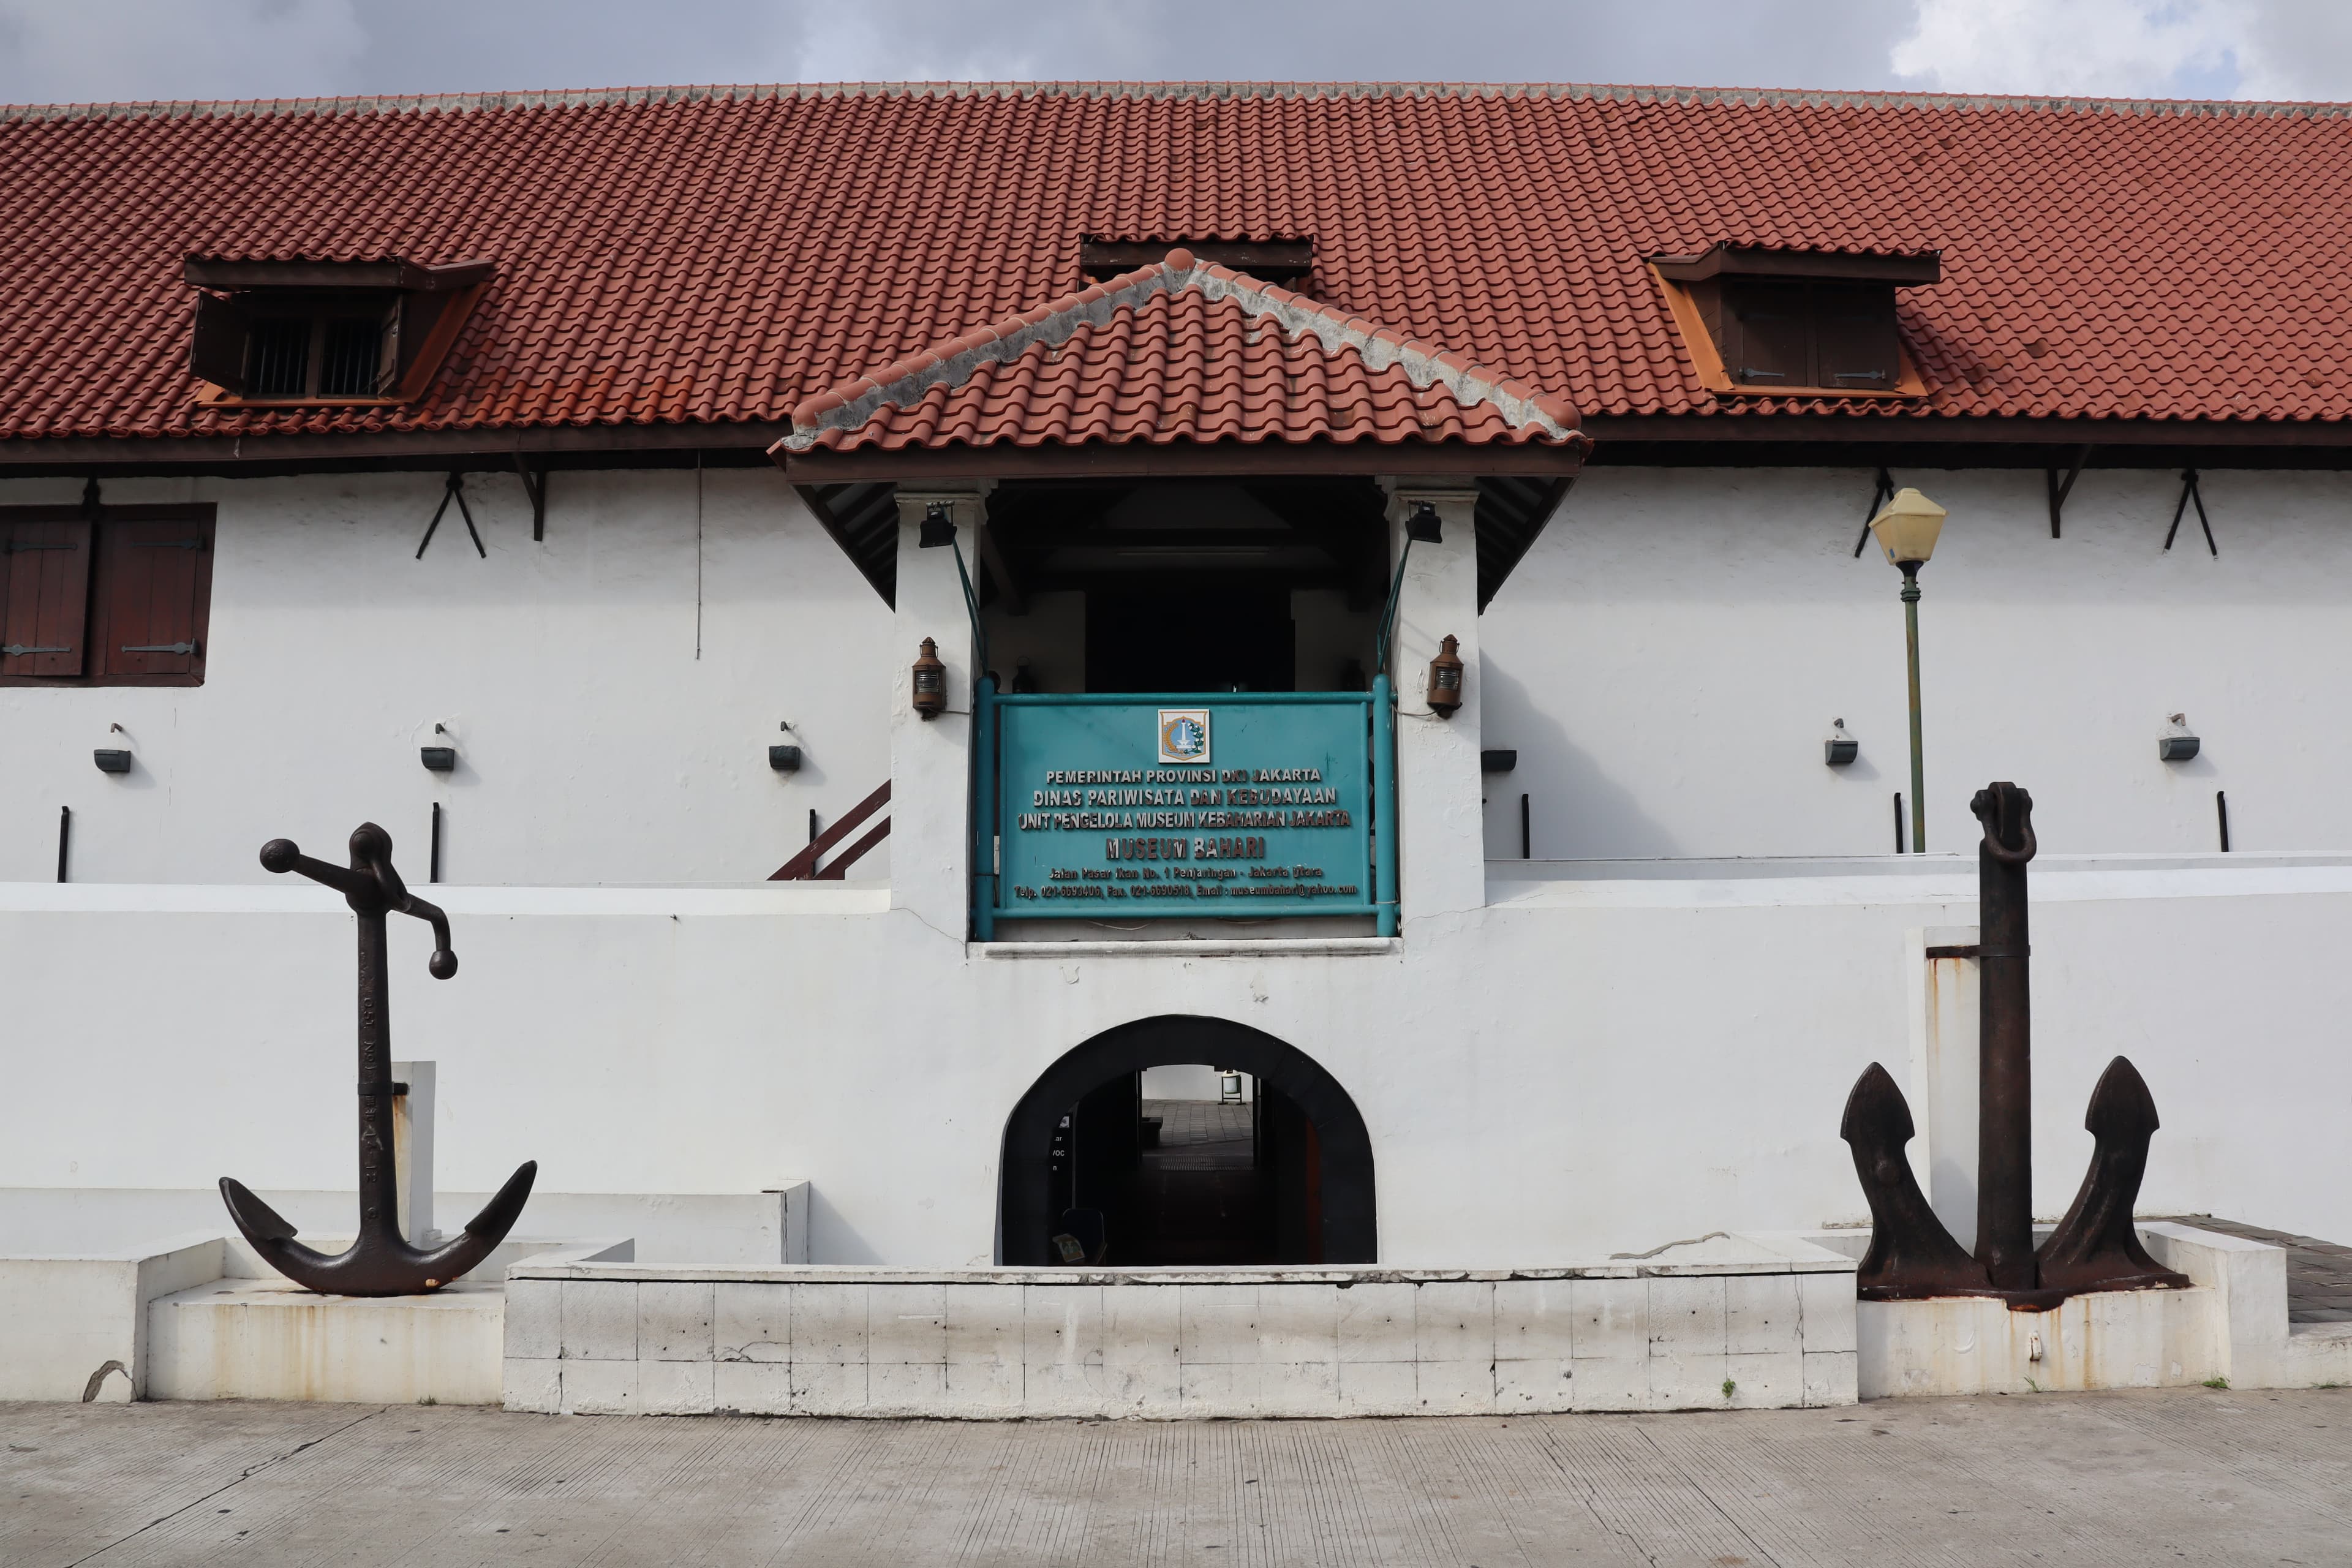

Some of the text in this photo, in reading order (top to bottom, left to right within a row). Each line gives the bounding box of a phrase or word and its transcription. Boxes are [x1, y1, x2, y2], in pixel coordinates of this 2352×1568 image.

[1046, 769, 1321, 784] PEMERINTAH PROVINSI DKI JAKARTA
[1033, 788, 1336, 807] DINAS PARIWISATA DAN KEBUDAYAAN
[1018, 810, 1351, 829] UNIT PENGELOLA MUSEUM KEBAHARIAN JAKARTA
[1106, 837, 1264, 859] MUSEUM BAHARI
[1049, 867, 1077, 879] Jalan
[1082, 867, 1112, 879] Pasar
[1115, 867, 1137, 878] Ikan
[1143, 867, 1159, 878] No.
[1164, 867, 1169, 878] 1
[1174, 867, 1236, 881] Penjaringan
[1248, 865, 1289, 877] Jakarta
[1292, 865, 1323, 878] Utara
[1014, 886, 1037, 899] Telp.
[1107, 885, 1128, 897] Fax.
